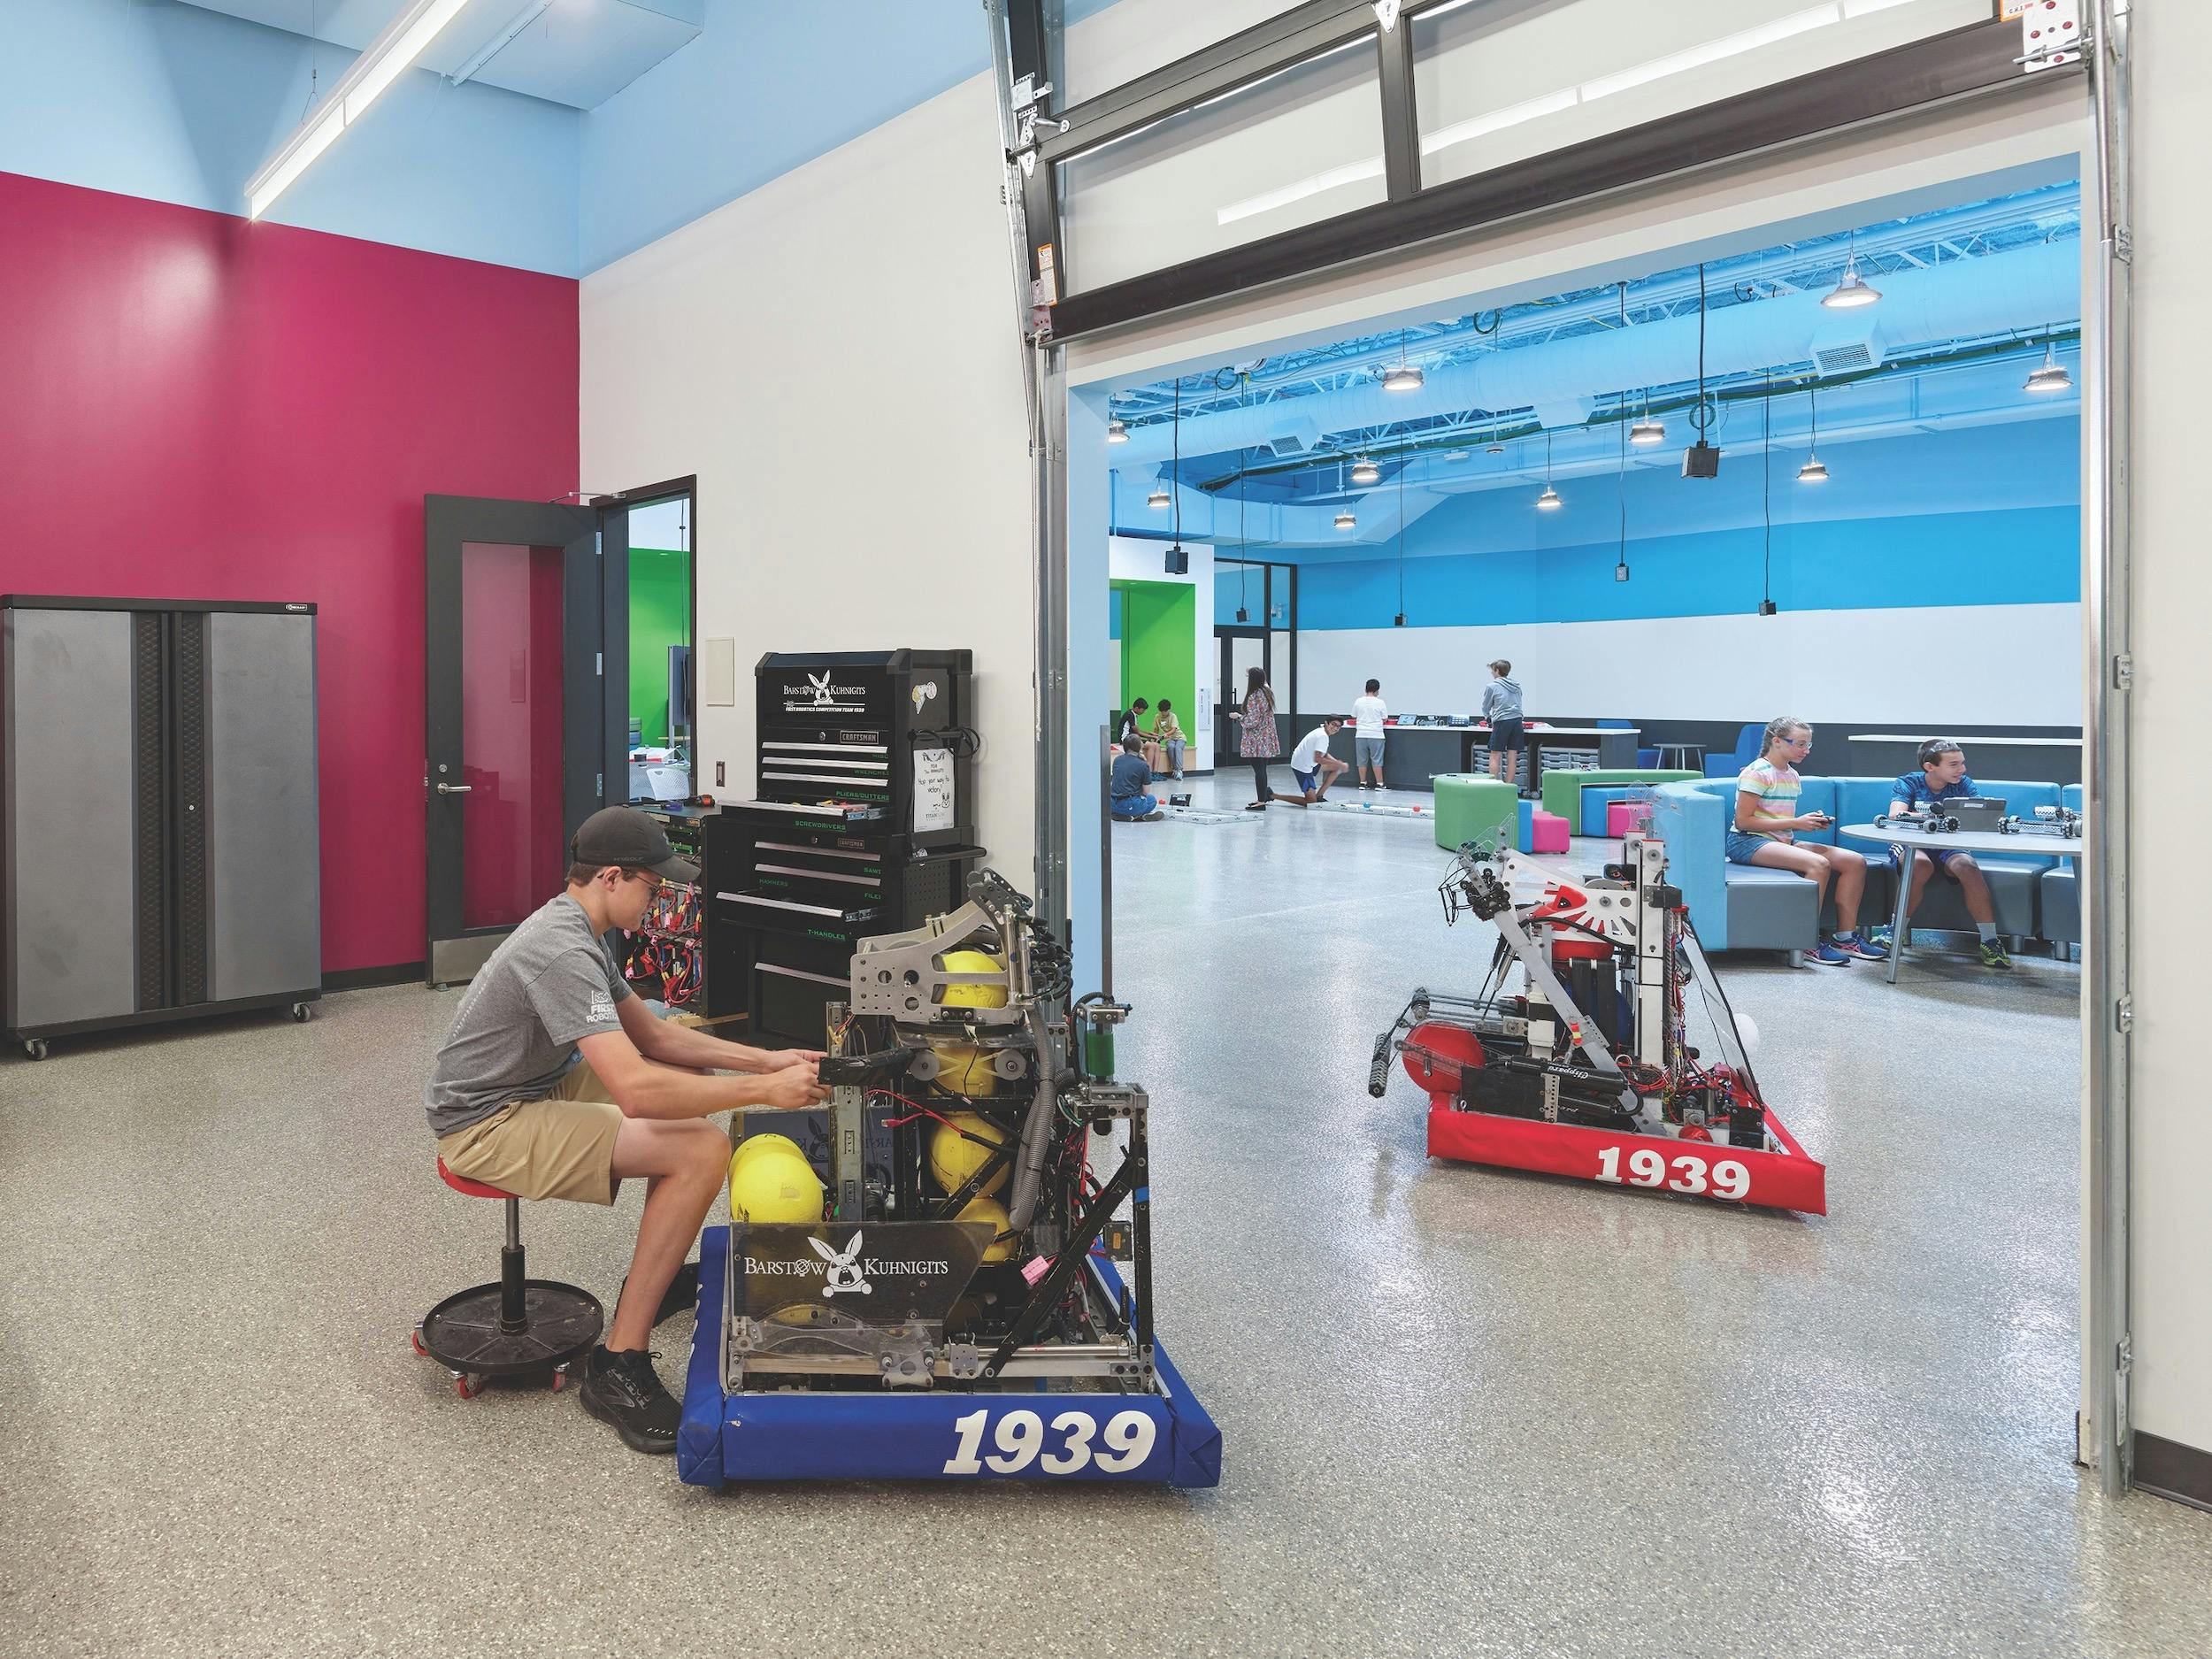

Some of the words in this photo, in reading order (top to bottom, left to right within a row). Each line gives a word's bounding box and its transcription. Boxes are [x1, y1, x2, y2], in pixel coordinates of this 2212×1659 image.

[835, 790, 890, 802] PLIERS/CUTTERS
[795, 820, 846, 830] SCREWDRIVERS
[807, 928, 846, 940] T-HANDLES
[1594, 1146, 1750, 1199] 1939
[744, 1256, 827, 1278] BARSTOW
[864, 1258, 949, 1275] KUHNIGITS
[943, 1409, 1156, 1475] 1939
